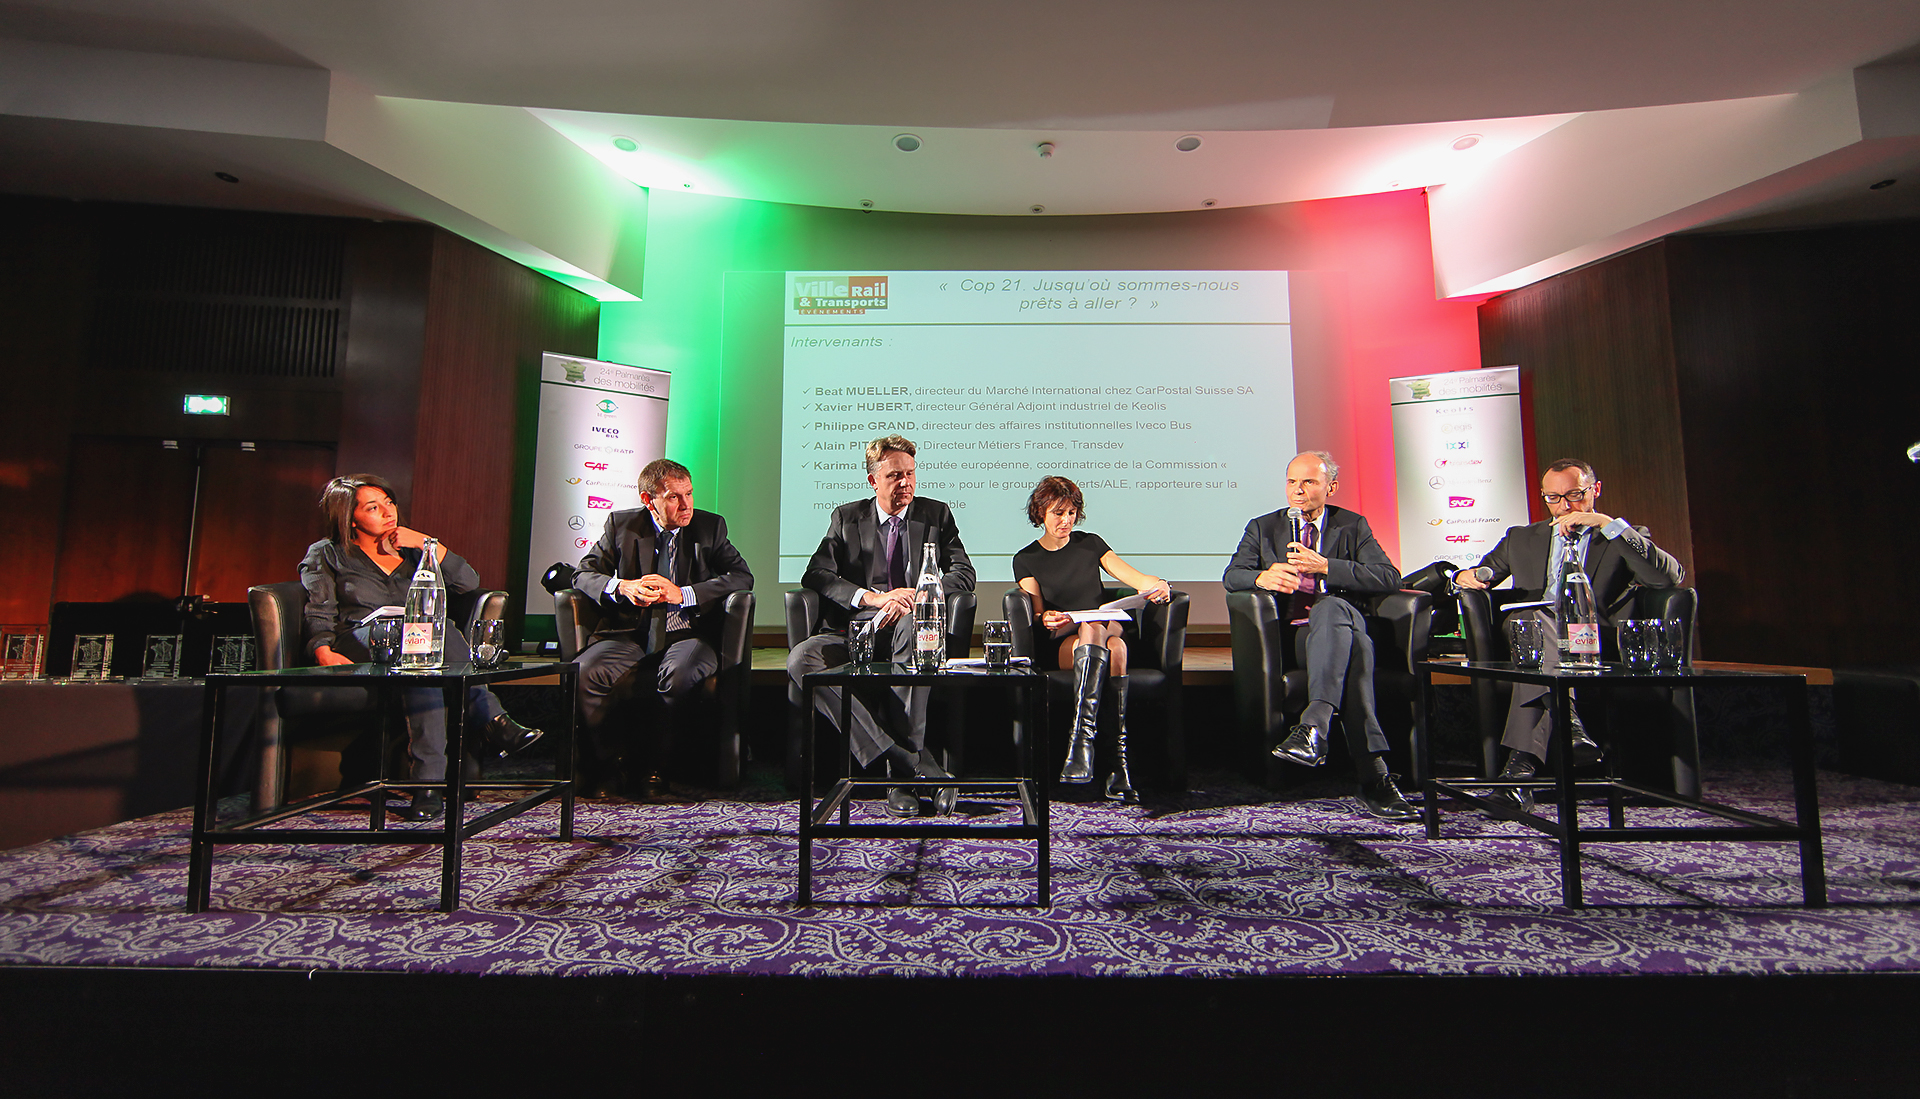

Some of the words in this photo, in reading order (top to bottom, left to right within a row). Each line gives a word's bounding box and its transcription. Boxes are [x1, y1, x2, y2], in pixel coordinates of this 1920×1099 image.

[794, 281, 848, 297] Ville
[851, 282, 886, 297] Rail
[960, 278, 995, 294] Cop
[1002, 279, 1026, 292] 21.
[1033, 278, 1111, 294] Jusqu'où
[1117, 280, 1240, 291] sommes-nous
[799, 297, 811, 307] &
[815, 298, 886, 309] Transports
[1019, 297, 1062, 312] prêts
[1067, 298, 1078, 310] à
[1084, 296, 1122, 310] aller
[1128, 296, 1138, 310] ?
[790, 336, 883, 348] Intervenants
[615, 369, 651, 382] Palmarès
[1459, 375, 1497, 384] Palmarès
[593, 376, 612, 387] des
[614, 378, 655, 393] mobilités
[1438, 387, 1457, 396] des
[1459, 382, 1503, 394] mobilités
[815, 387, 843, 396] Beat
[846, 386, 912, 397] MUELLER,
[915, 386, 965, 395] directeur
[967, 386, 982, 395] du
[985, 386, 1029, 395] Marché
[1031, 386, 1102, 395] International
[1104, 386, 1132, 395] chez
[1135, 386, 1192, 395] CarPostal
[1195, 386, 1234, 395] Suisse
[1236, 386, 1254, 395] SA
[814, 402, 853, 412] Xavier
[857, 402, 914, 413] HUBERT,
[915, 402, 966, 411] directeur
[969, 401, 1014, 411] Général
[1016, 402, 1057, 413] Adjoint
[1059, 401, 1111, 411] industriel
[1114, 402, 1128, 411] de
[1131, 402, 1167, 411] Keolis
[591, 426, 619, 435] IVECO
[814, 421, 865, 433] Philippe
[867, 421, 919, 432] GRAND,
[921, 421, 972, 430] directeur
[974, 421, 995, 430] des
[999, 421, 1041, 430] affaires
[1044, 421, 1133, 430] institutionnelles
[1135, 421, 1167, 430] Iveco
[1170, 421, 1192, 430] Bus
[573, 443, 603, 452] GROUPE
[813, 441, 845, 450] Alain
[923, 440, 976, 450] Directeur
[978, 440, 1021, 450] Métiers
[1024, 440, 1067, 451] France,
[1071, 440, 1124, 449] Transdev
[584, 461, 609, 471] CAF
[813, 461, 857, 470] Karima
[961, 460, 1033, 471] européenne,
[1036, 460, 1112, 470] coordinatrice
[1114, 460, 1129, 469] de
[1132, 460, 1143, 469] la
[1145, 459, 1218, 469] Commission
[616, 482, 638, 490] France
[958, 481, 985, 491] pour
[988, 480, 999, 489] le
[1135, 480, 1203, 490] rapporteure
[1205, 481, 1224, 489] sur
[1227, 479, 1237, 489] la
[589, 500, 613, 509] SNCF
[1449, 499, 1474, 508] SNCF
[1445, 535, 1470, 544] CAF
[405, 636, 426, 645] evian
[918, 633, 939, 642] evian
[1575, 637, 1598, 645] evian
